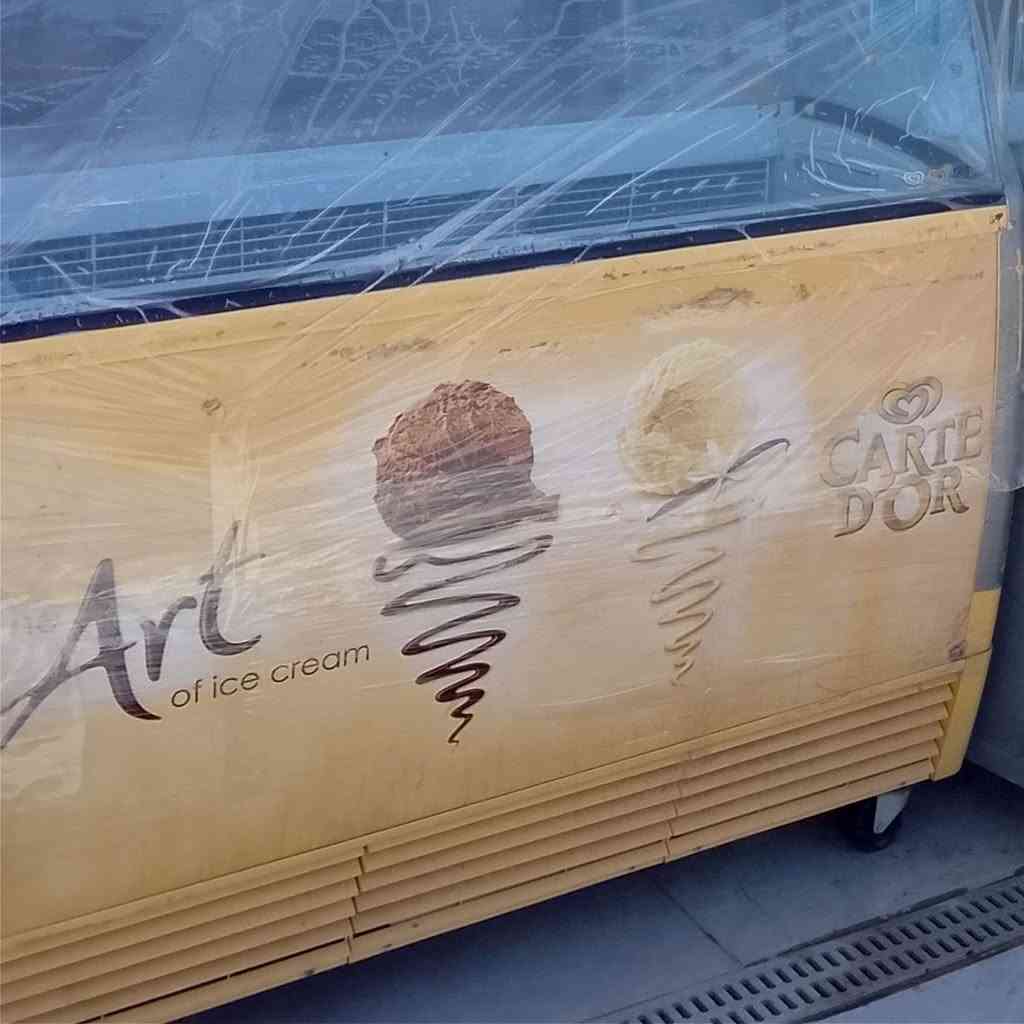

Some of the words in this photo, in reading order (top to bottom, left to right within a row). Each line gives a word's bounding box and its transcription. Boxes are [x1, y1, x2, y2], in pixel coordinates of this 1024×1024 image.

[820, 405, 984, 488] CARTE
[0, 520, 266, 750] Art
[171, 678, 202, 708] of
[212, 671, 260, 699] ice
[271, 643, 370, 683] cream
